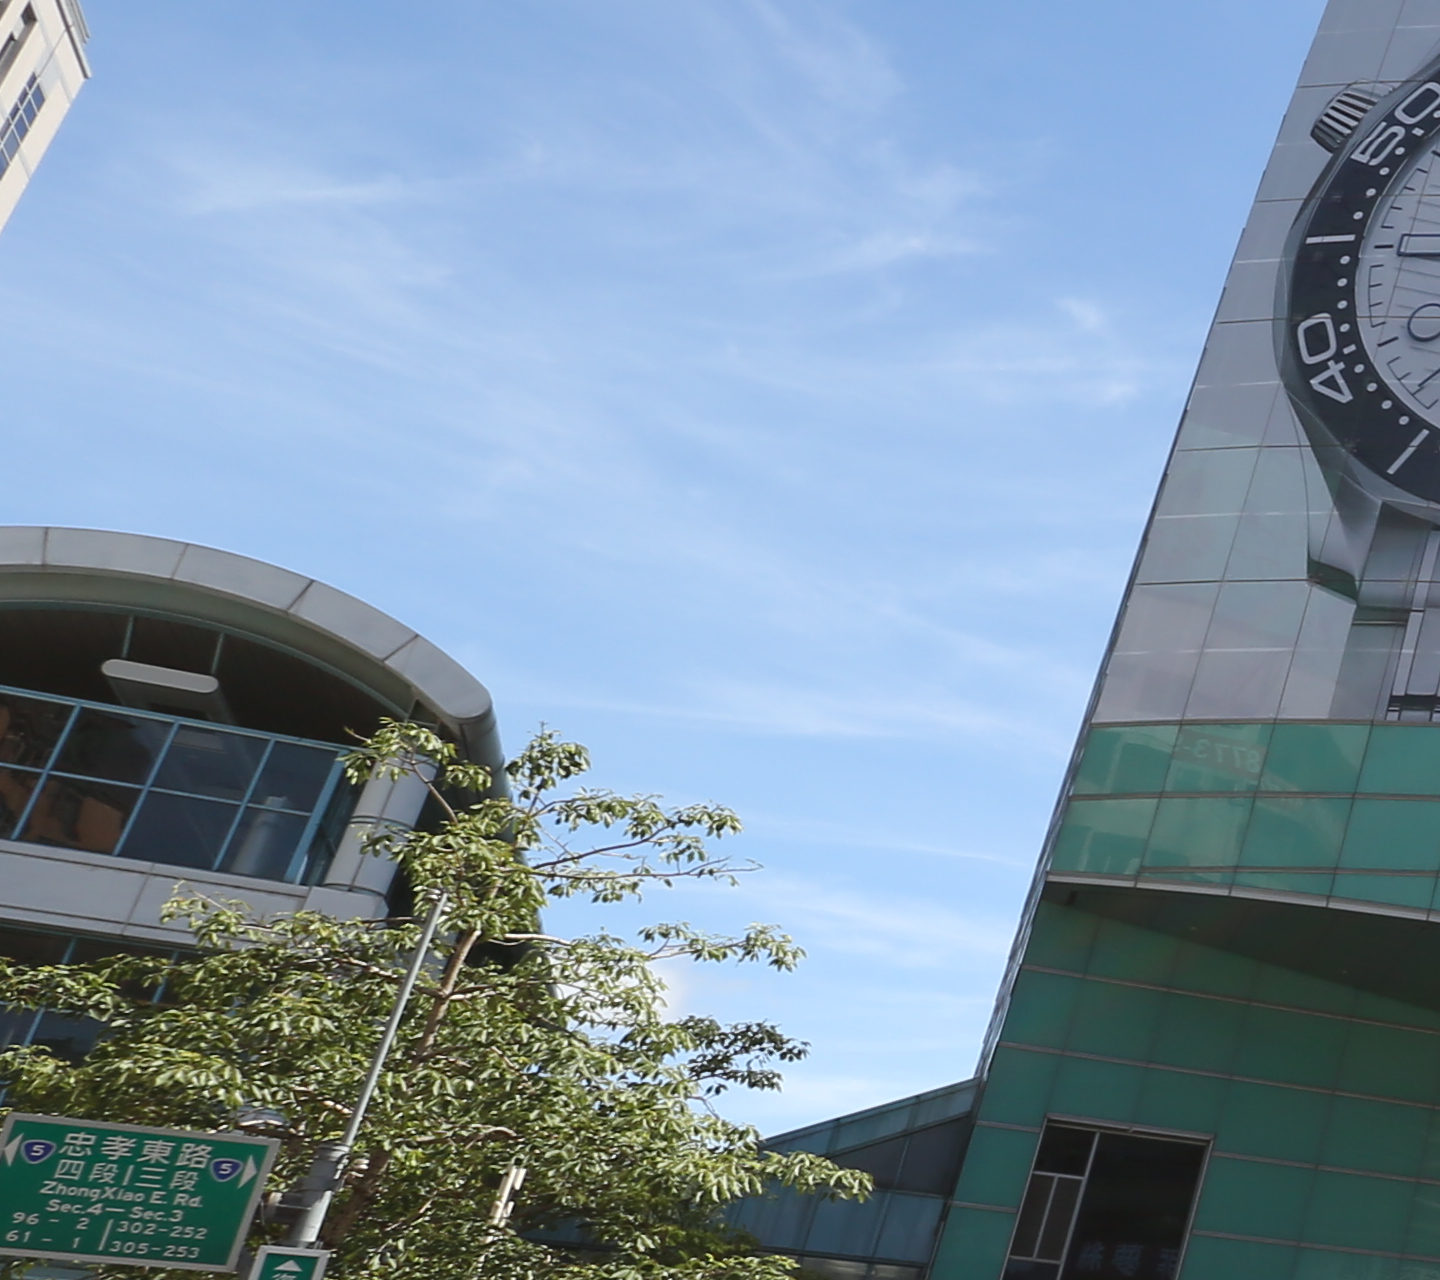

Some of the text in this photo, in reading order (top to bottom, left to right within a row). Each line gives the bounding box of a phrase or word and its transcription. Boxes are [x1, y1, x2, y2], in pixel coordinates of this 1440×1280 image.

[1296, 311, 1354, 404] 40
[31, 1144, 45, 1157] 5
[58, 1131, 214, 1170] 忠孝東路
[53, 1159, 200, 1192] 四段 三段
[219, 1163, 234, 1175] 5
[39, 1180, 204, 1208] ZhongXiao E. Rd.
[12, 1211, 40, 1226] 96
[76, 1217, 91, 1231] 2
[116, 1220, 209, 1241] 302-252
[46, 1199, 103, 1215] Sec.4
[128, 1207, 185, 1223] Sec.3
[5, 1229, 31, 1244] 61
[109, 1240, 201, 1260] 305-253
